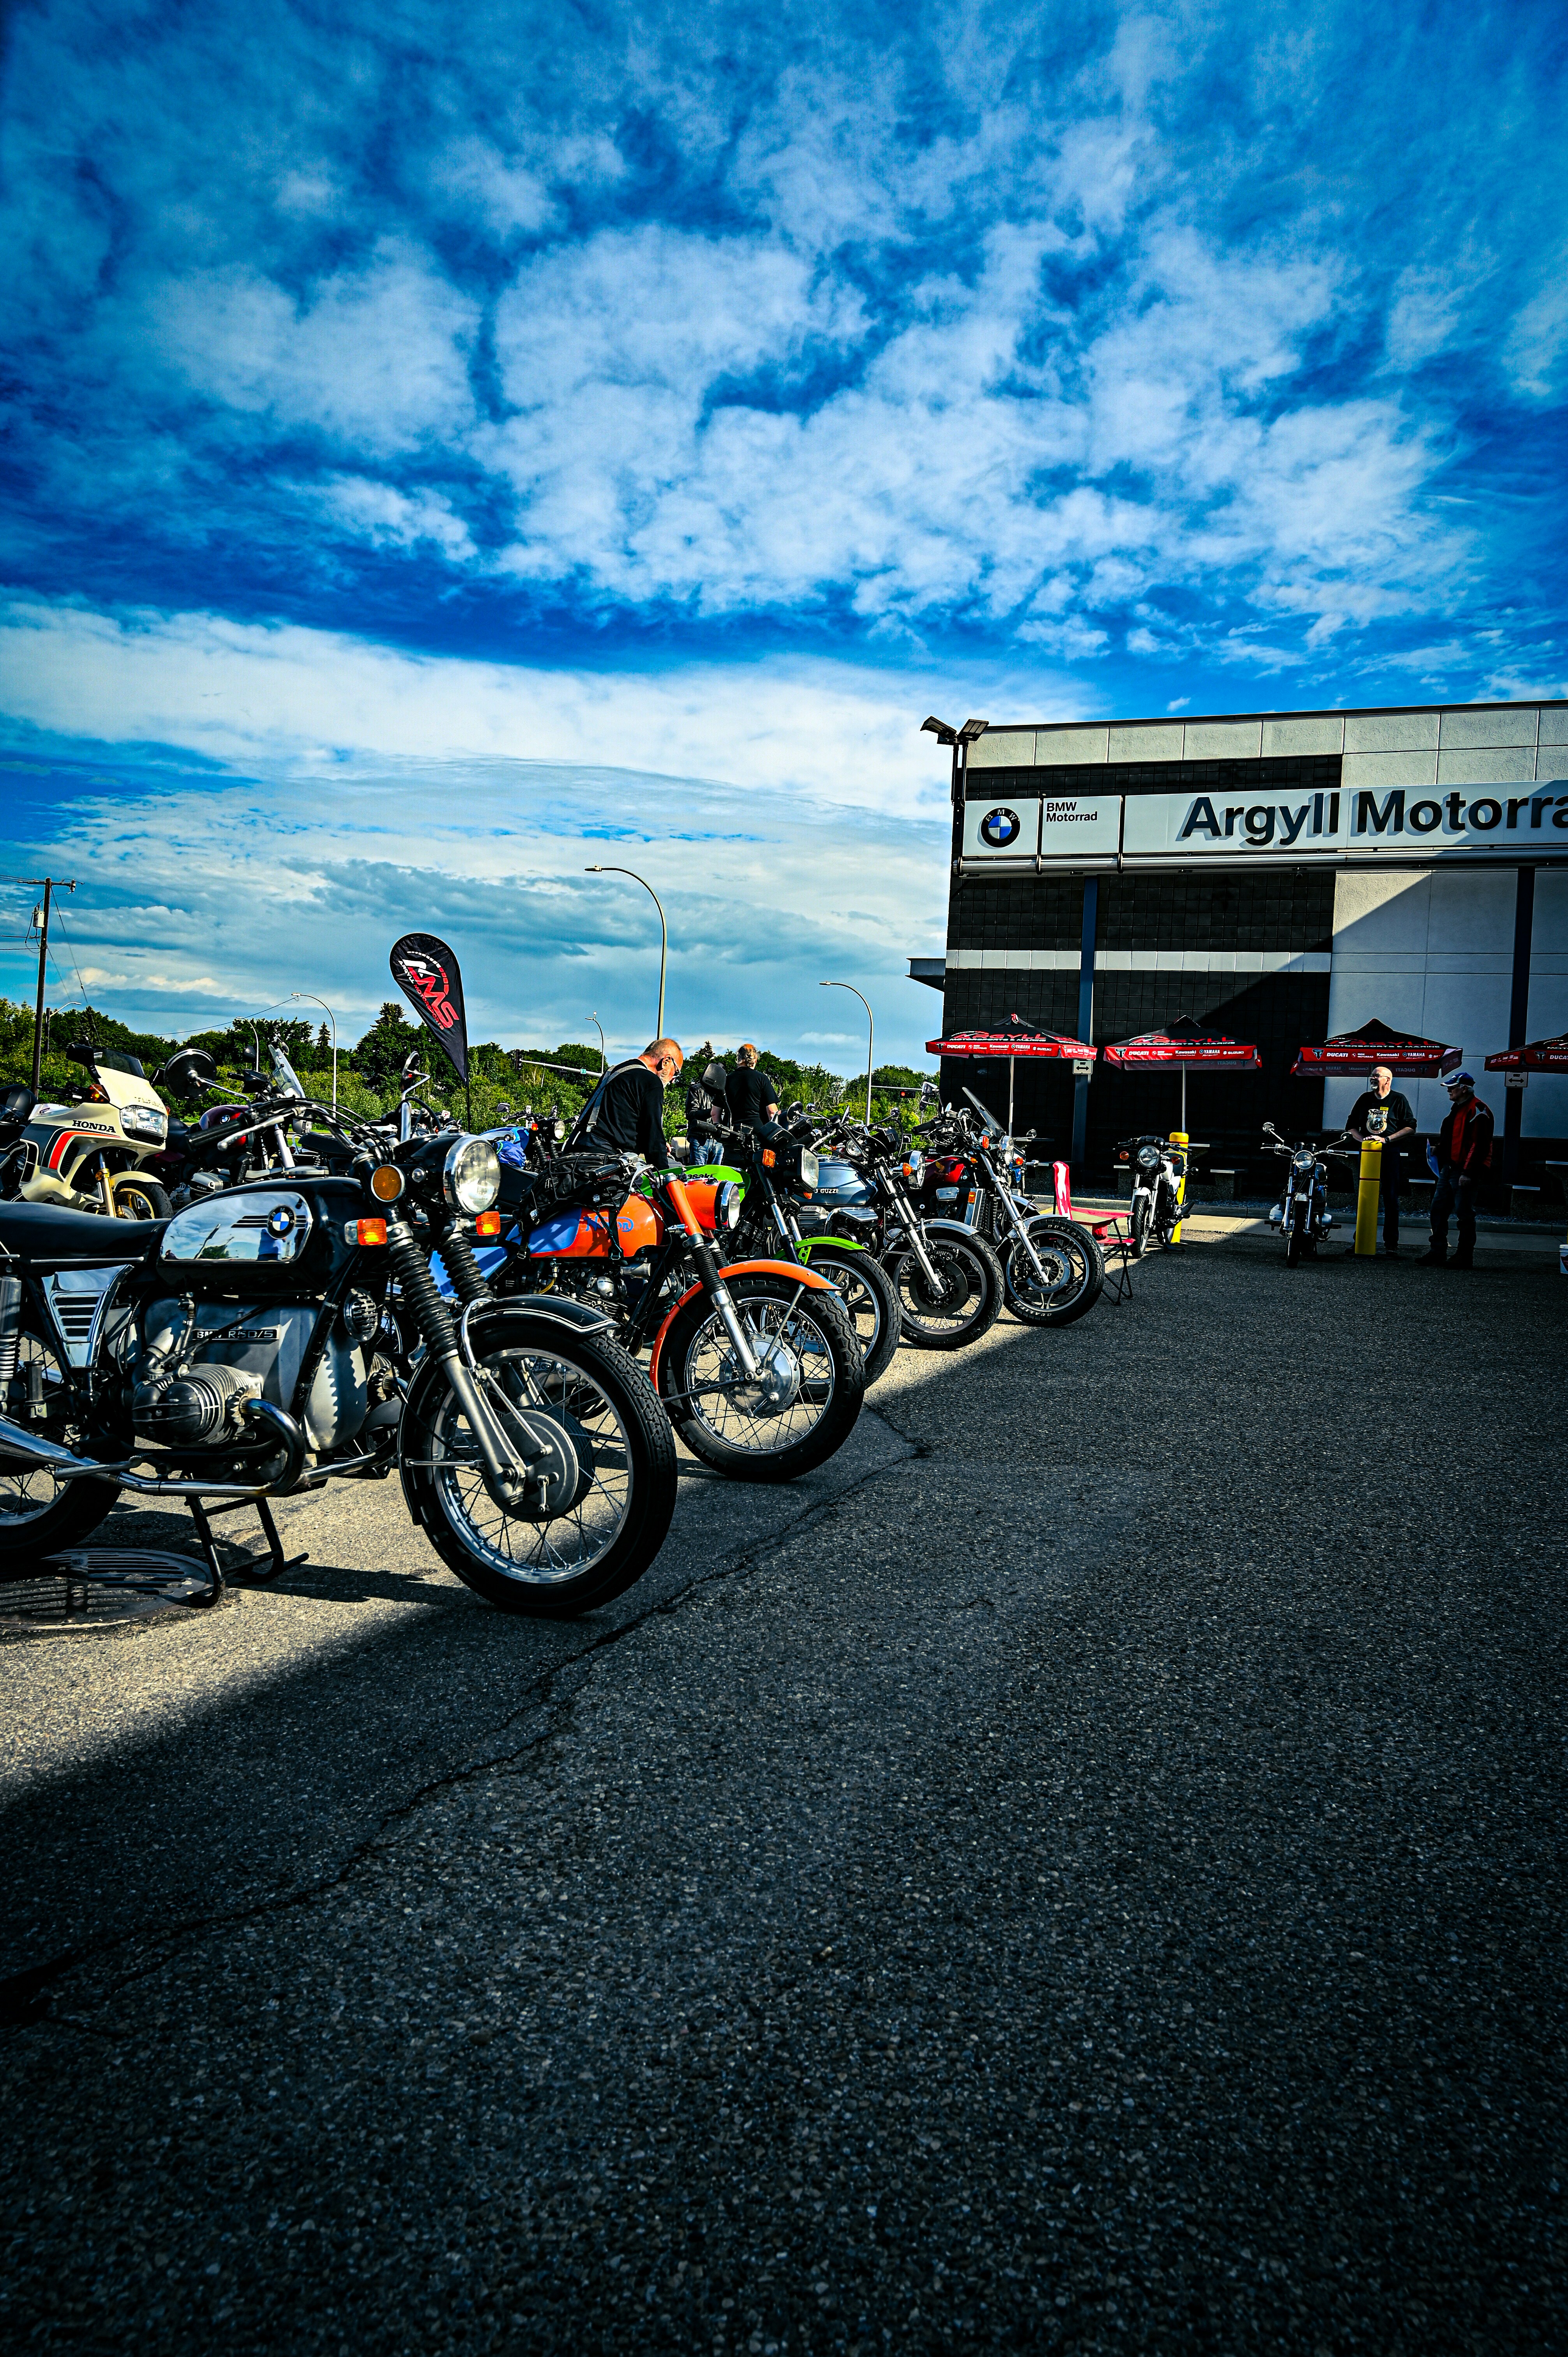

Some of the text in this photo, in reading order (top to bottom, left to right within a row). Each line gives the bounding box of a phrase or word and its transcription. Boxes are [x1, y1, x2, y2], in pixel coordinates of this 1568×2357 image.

[1047, 802, 1077, 812] BMW
[986, 809, 1017, 822] BMW
[1046, 811, 1098, 822] Motorrad
[1182, 792, 1338, 845] Argyll
[398, 960, 444, 1030] ARGYLL MOTORSPORTS
[72, 1120, 116, 1133] HONDA
[271, 1208, 293, 1217] BMW
[1047, 1224, 1081, 1239] DUNLOP
